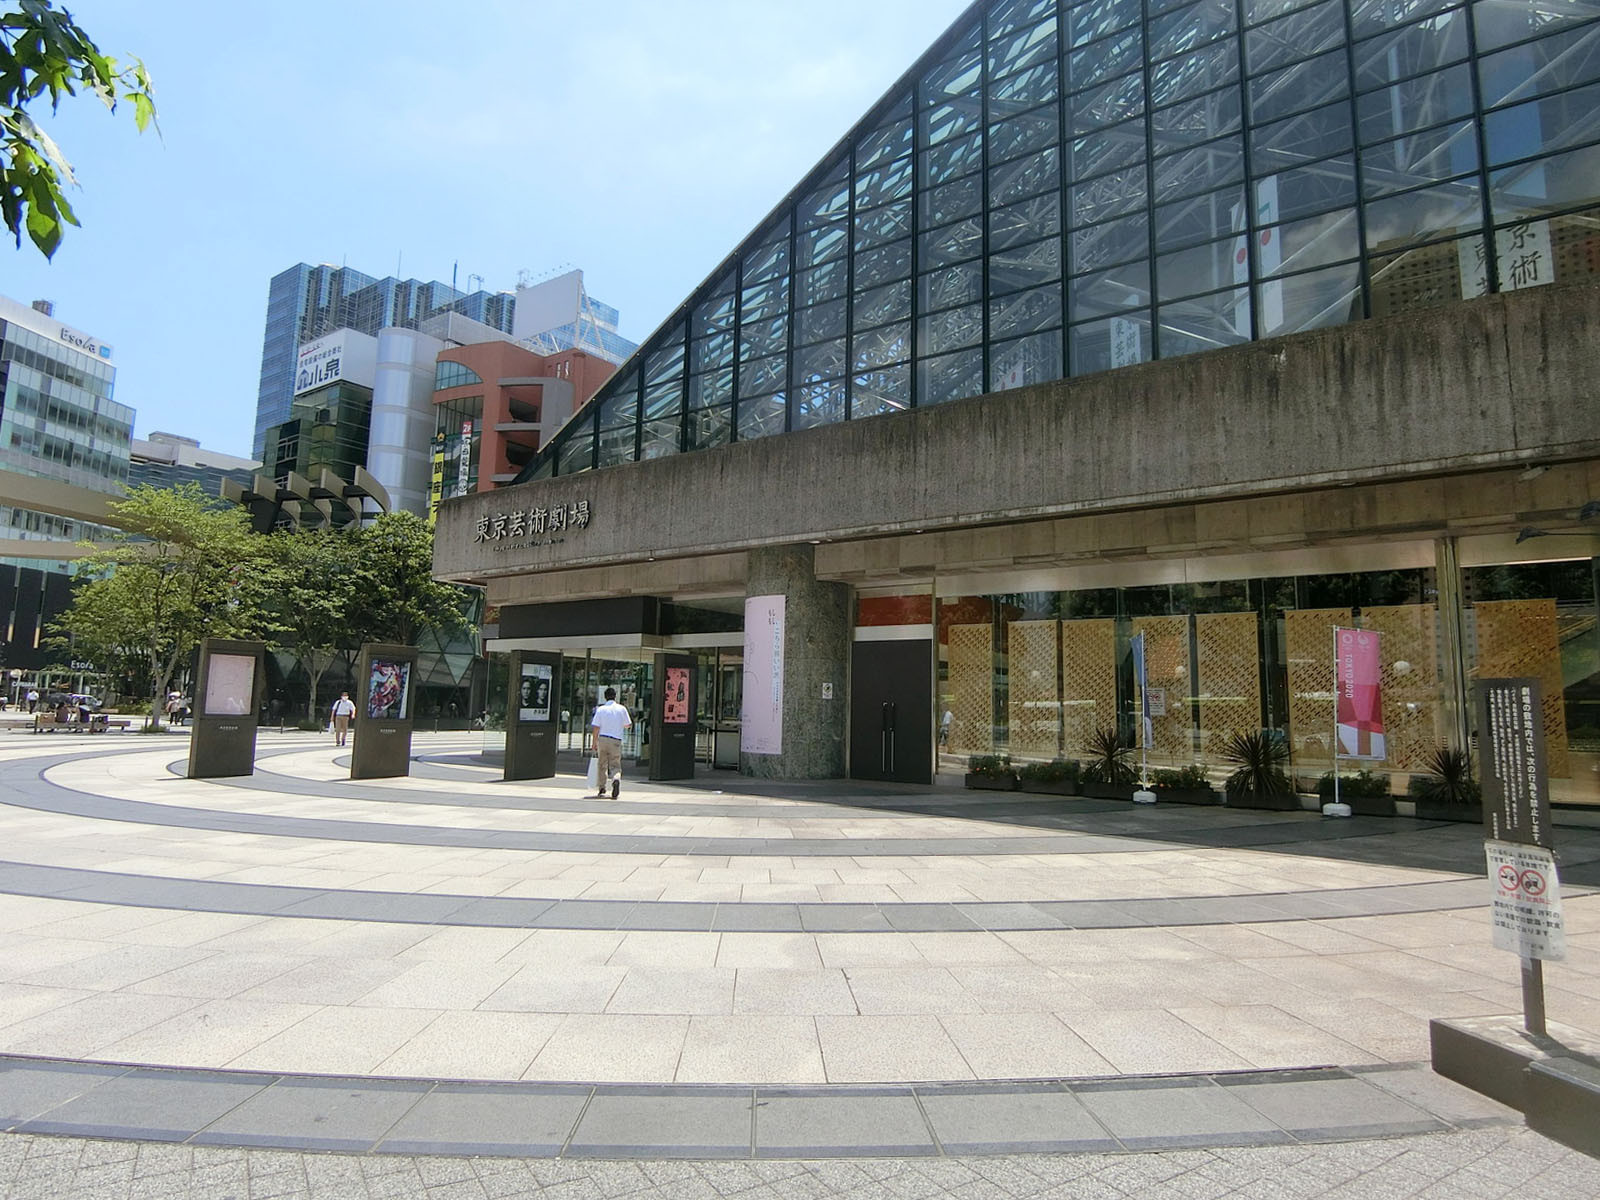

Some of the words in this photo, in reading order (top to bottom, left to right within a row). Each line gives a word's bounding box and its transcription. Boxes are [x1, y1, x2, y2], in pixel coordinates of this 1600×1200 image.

[61, 327, 96, 353] Esola
[474, 500, 591, 543] 東京芸術劇場
[70, 660, 94, 669] Esola
[1345, 654, 1353, 678] TOKYO
[1345, 679, 1354, 698] 2020
